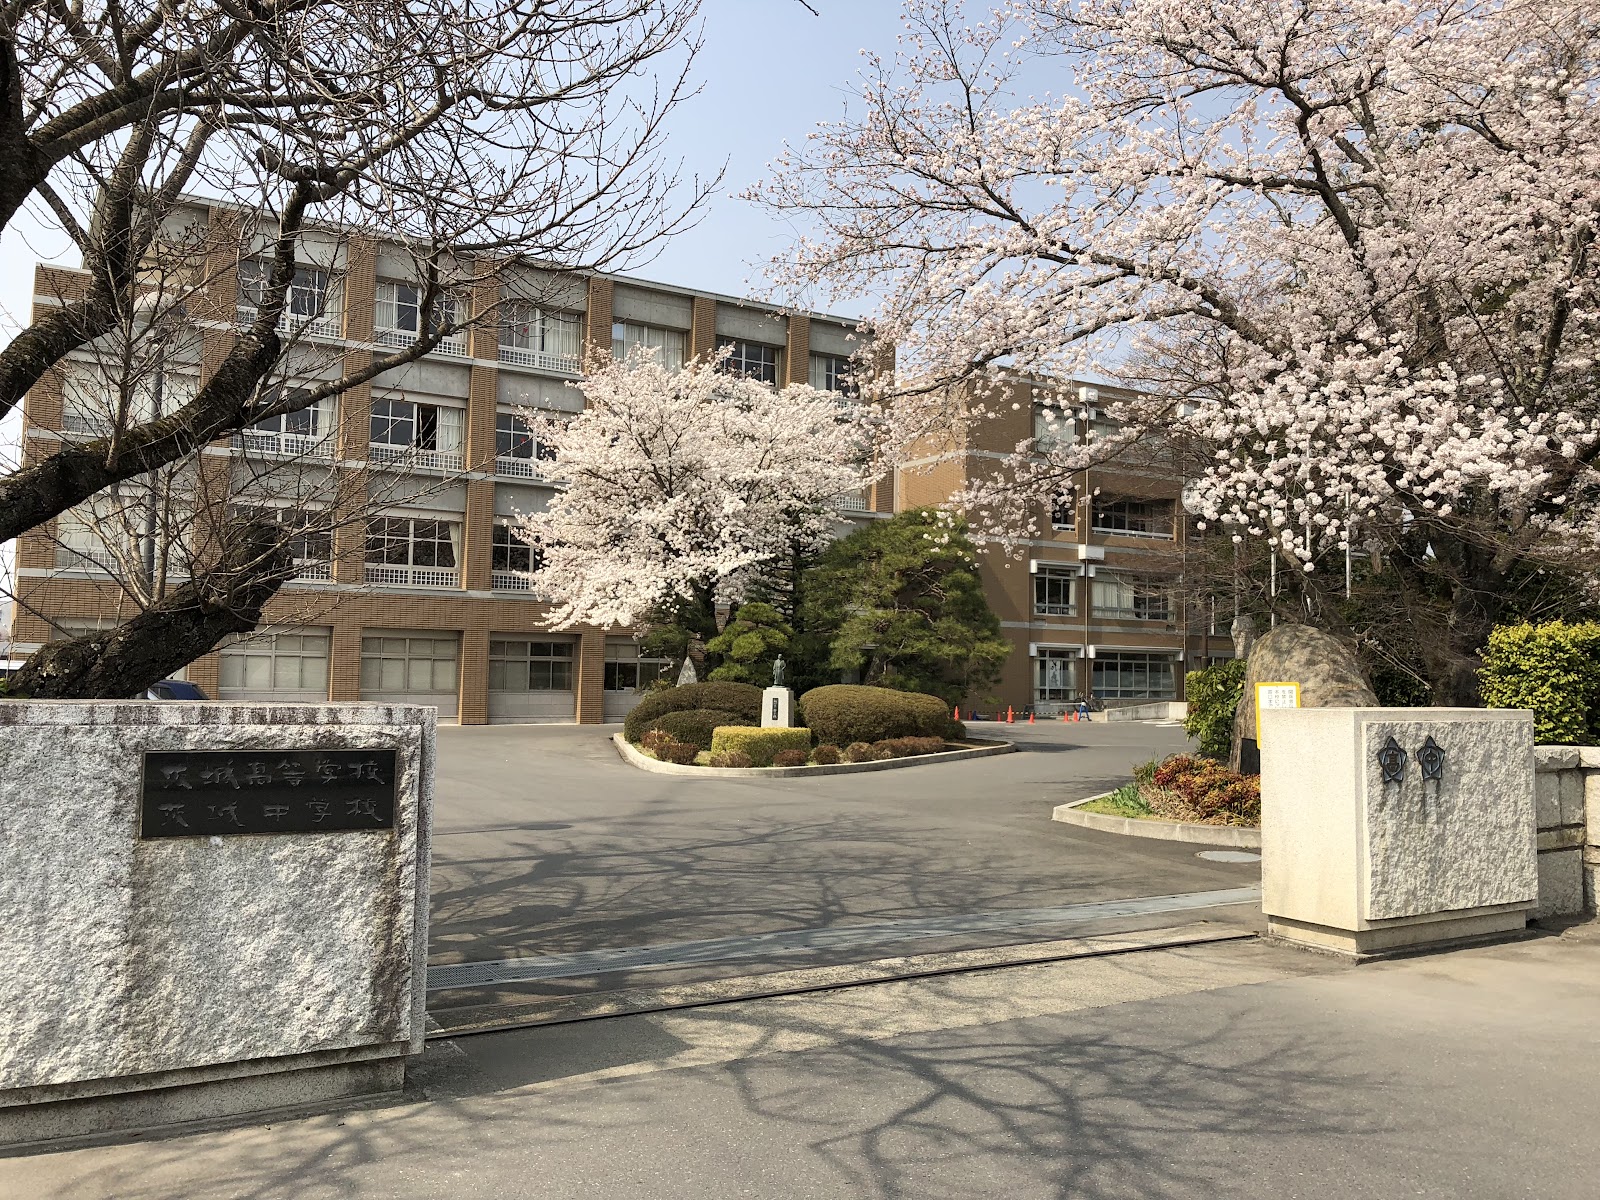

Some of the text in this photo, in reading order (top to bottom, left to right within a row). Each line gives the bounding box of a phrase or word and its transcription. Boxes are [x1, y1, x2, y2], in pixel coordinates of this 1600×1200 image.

[160, 758, 385, 790] 茨城高等学校
[158, 797, 384, 828] 茨城中学校
